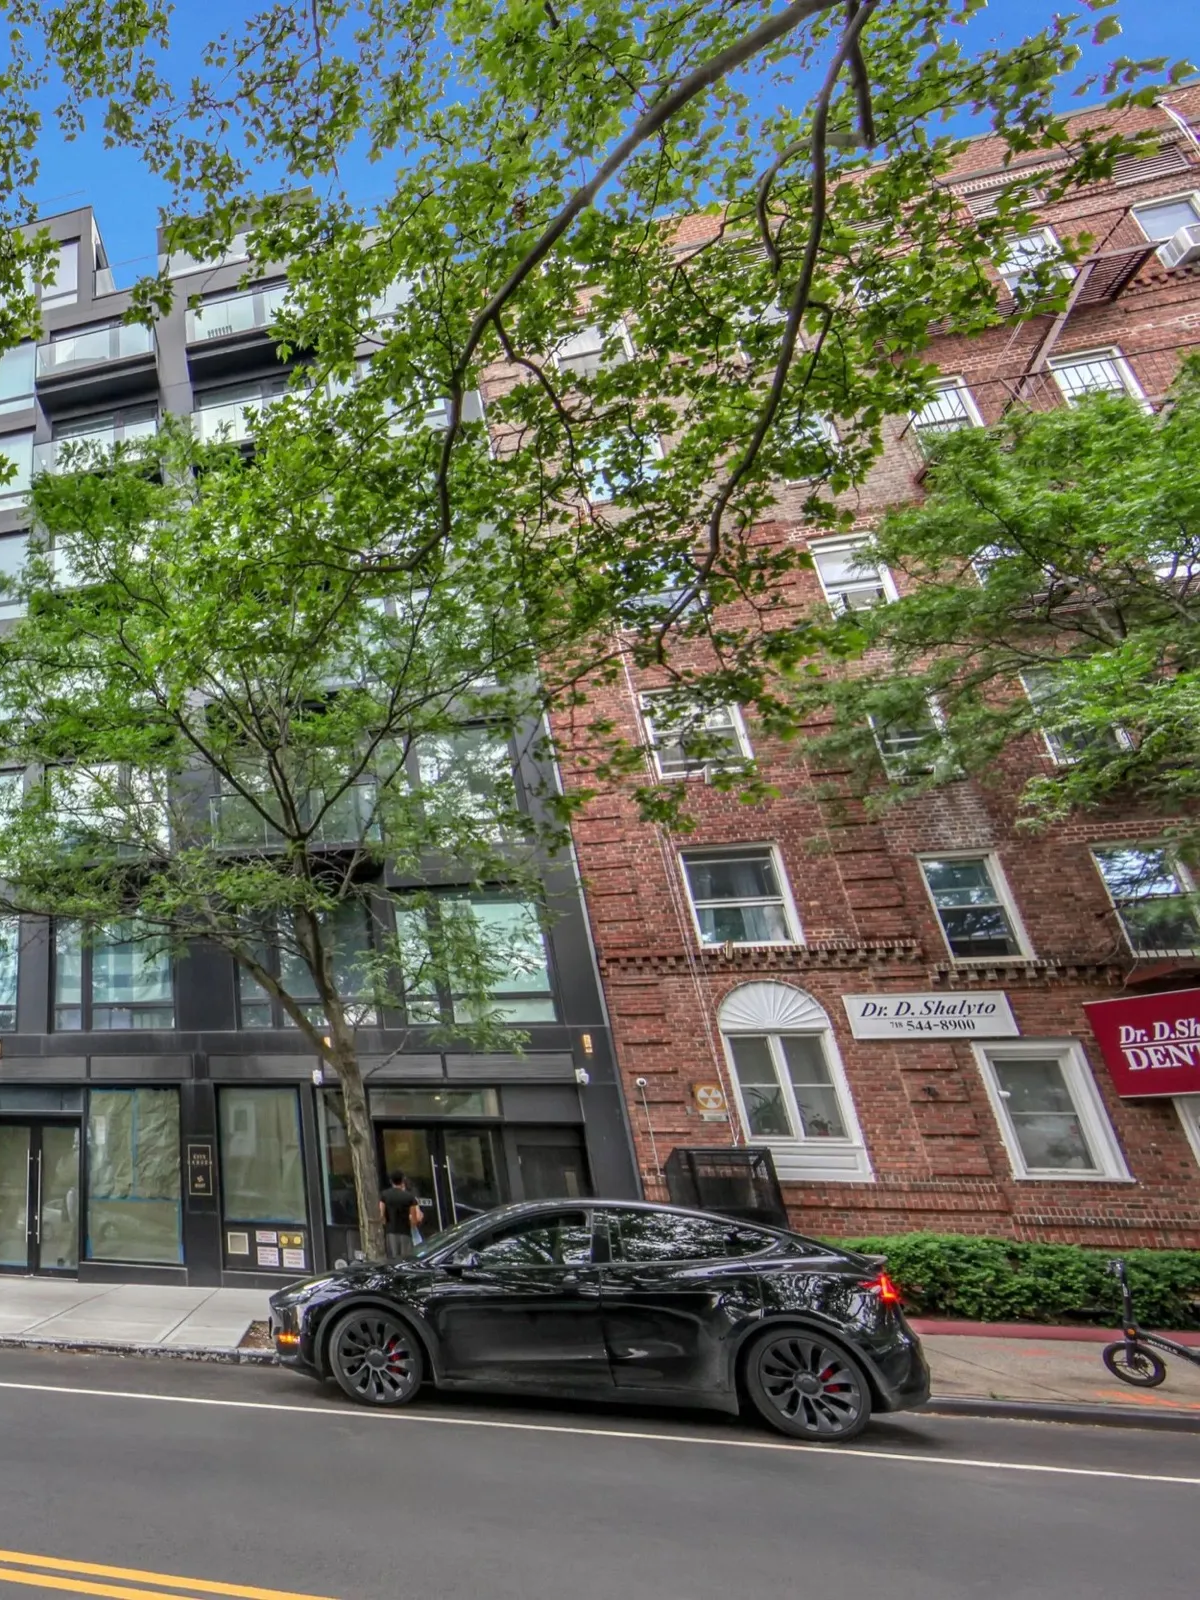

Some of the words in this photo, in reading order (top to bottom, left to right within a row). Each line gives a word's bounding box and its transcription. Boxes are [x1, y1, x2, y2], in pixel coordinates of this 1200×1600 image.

[860, 1002, 888, 1017] Dr.
[894, 1001, 915, 1016] D.
[920, 999, 996, 1018] Shalyto
[907, 1019, 975, 1031] 544-8900
[1119, 1025, 1149, 1044] Dr.
